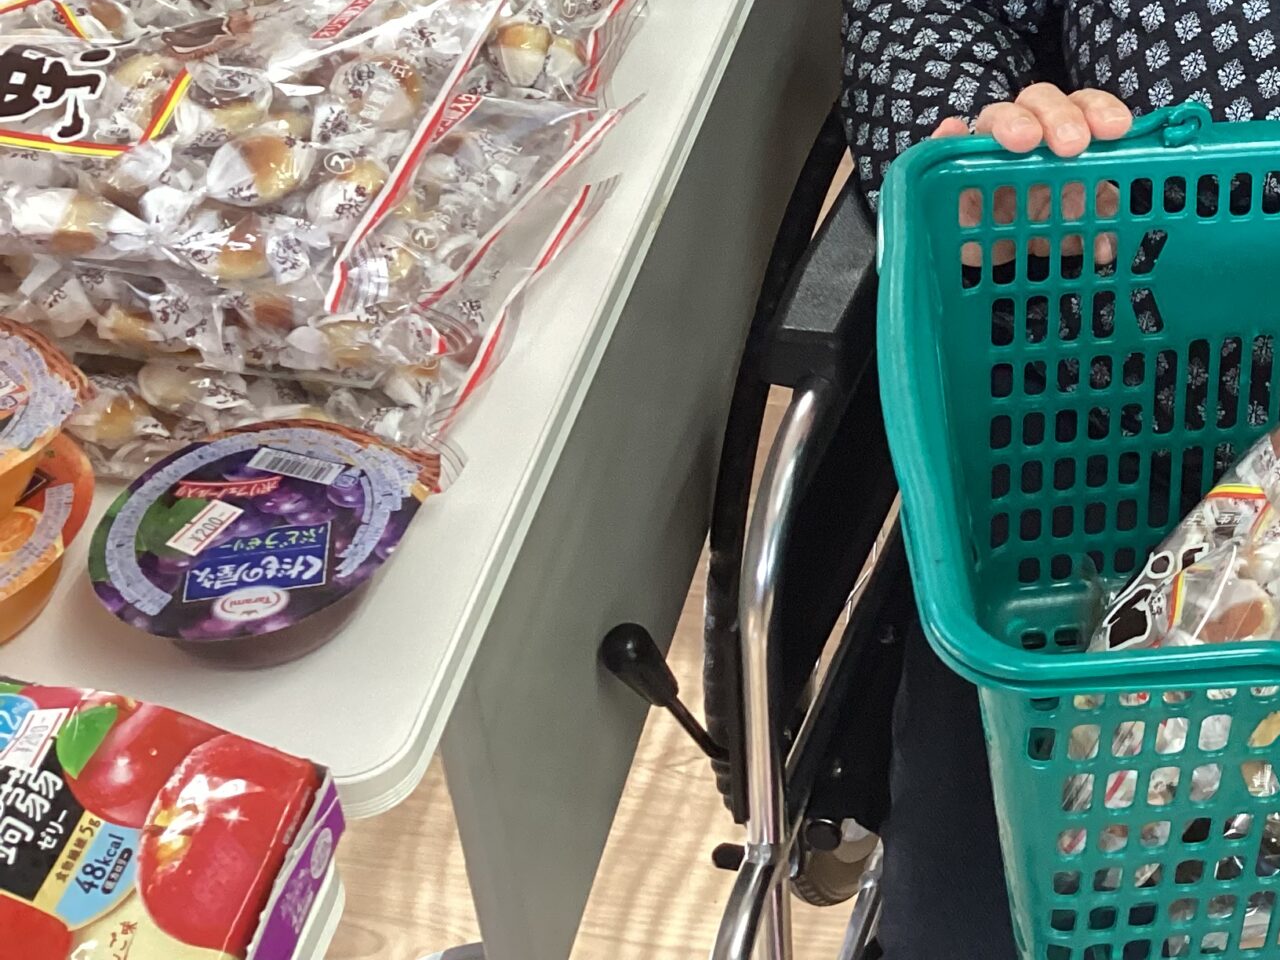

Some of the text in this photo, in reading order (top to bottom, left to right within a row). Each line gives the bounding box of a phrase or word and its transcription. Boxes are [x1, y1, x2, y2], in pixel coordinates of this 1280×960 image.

[218, 525, 324, 552] ぶどうゼリー
[191, 554, 323, 590] くだもの屋さん
[228, 594, 274, 609] Tarami
[37, 809, 69, 851] ゼリー
